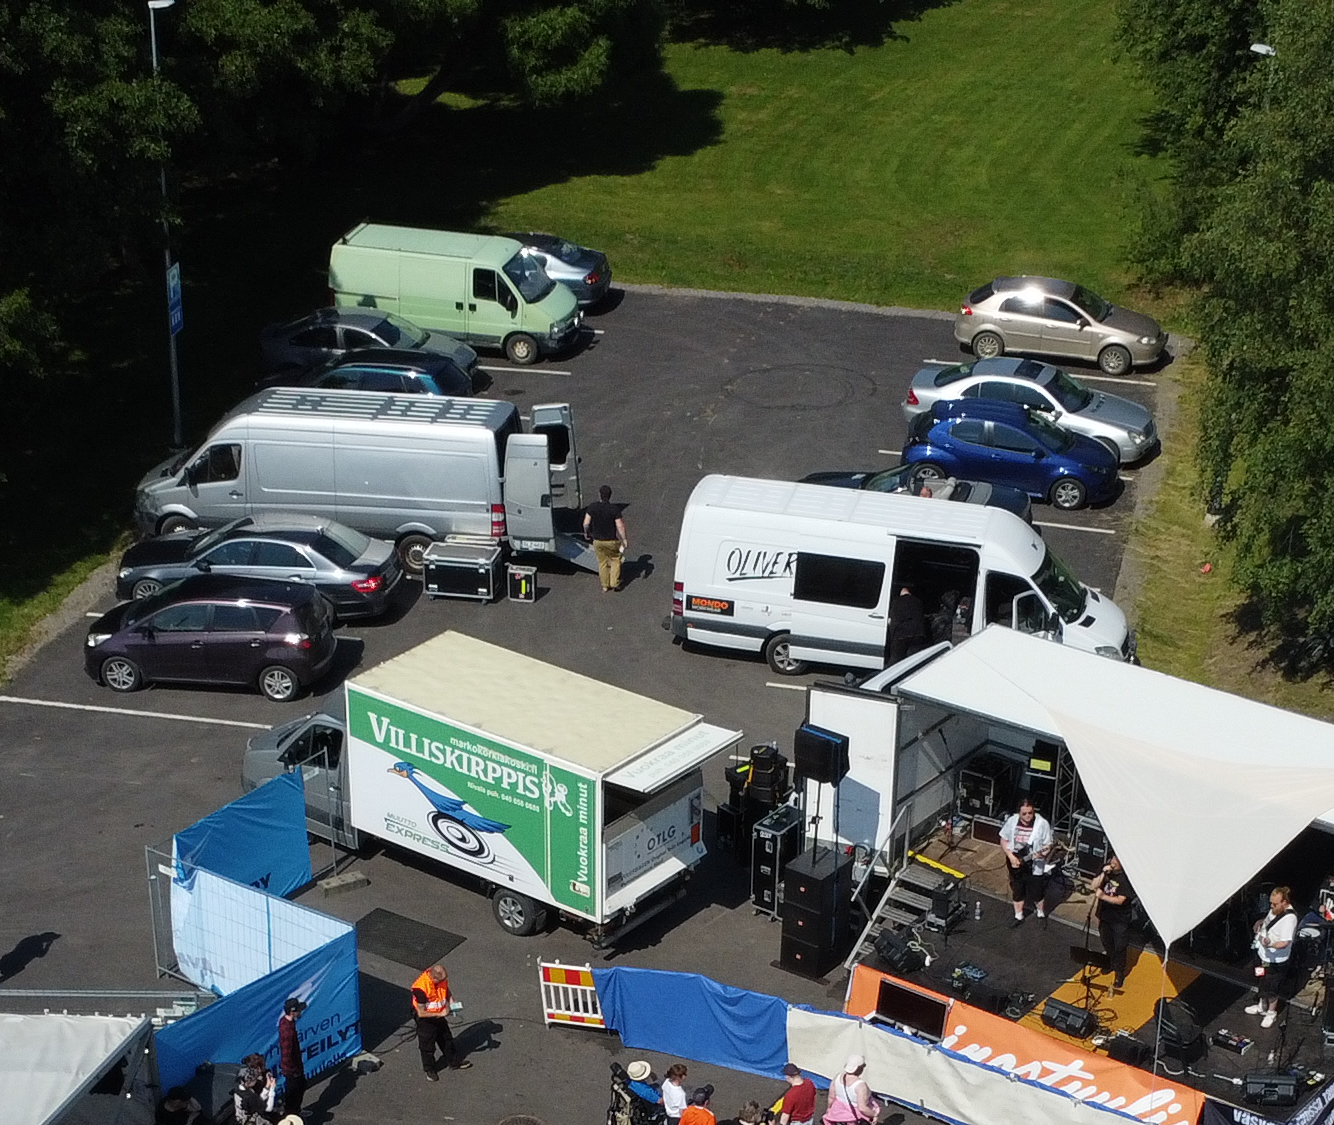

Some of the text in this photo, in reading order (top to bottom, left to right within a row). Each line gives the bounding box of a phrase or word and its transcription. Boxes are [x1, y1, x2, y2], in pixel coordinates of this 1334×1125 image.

[727, 547, 798, 577] OLIVER
[692, 597, 729, 610] MONDO
[577, 782, 588, 824] minut
[386, 822, 450, 853] EXPRESS
[577, 827, 588, 881] Vuokraa
